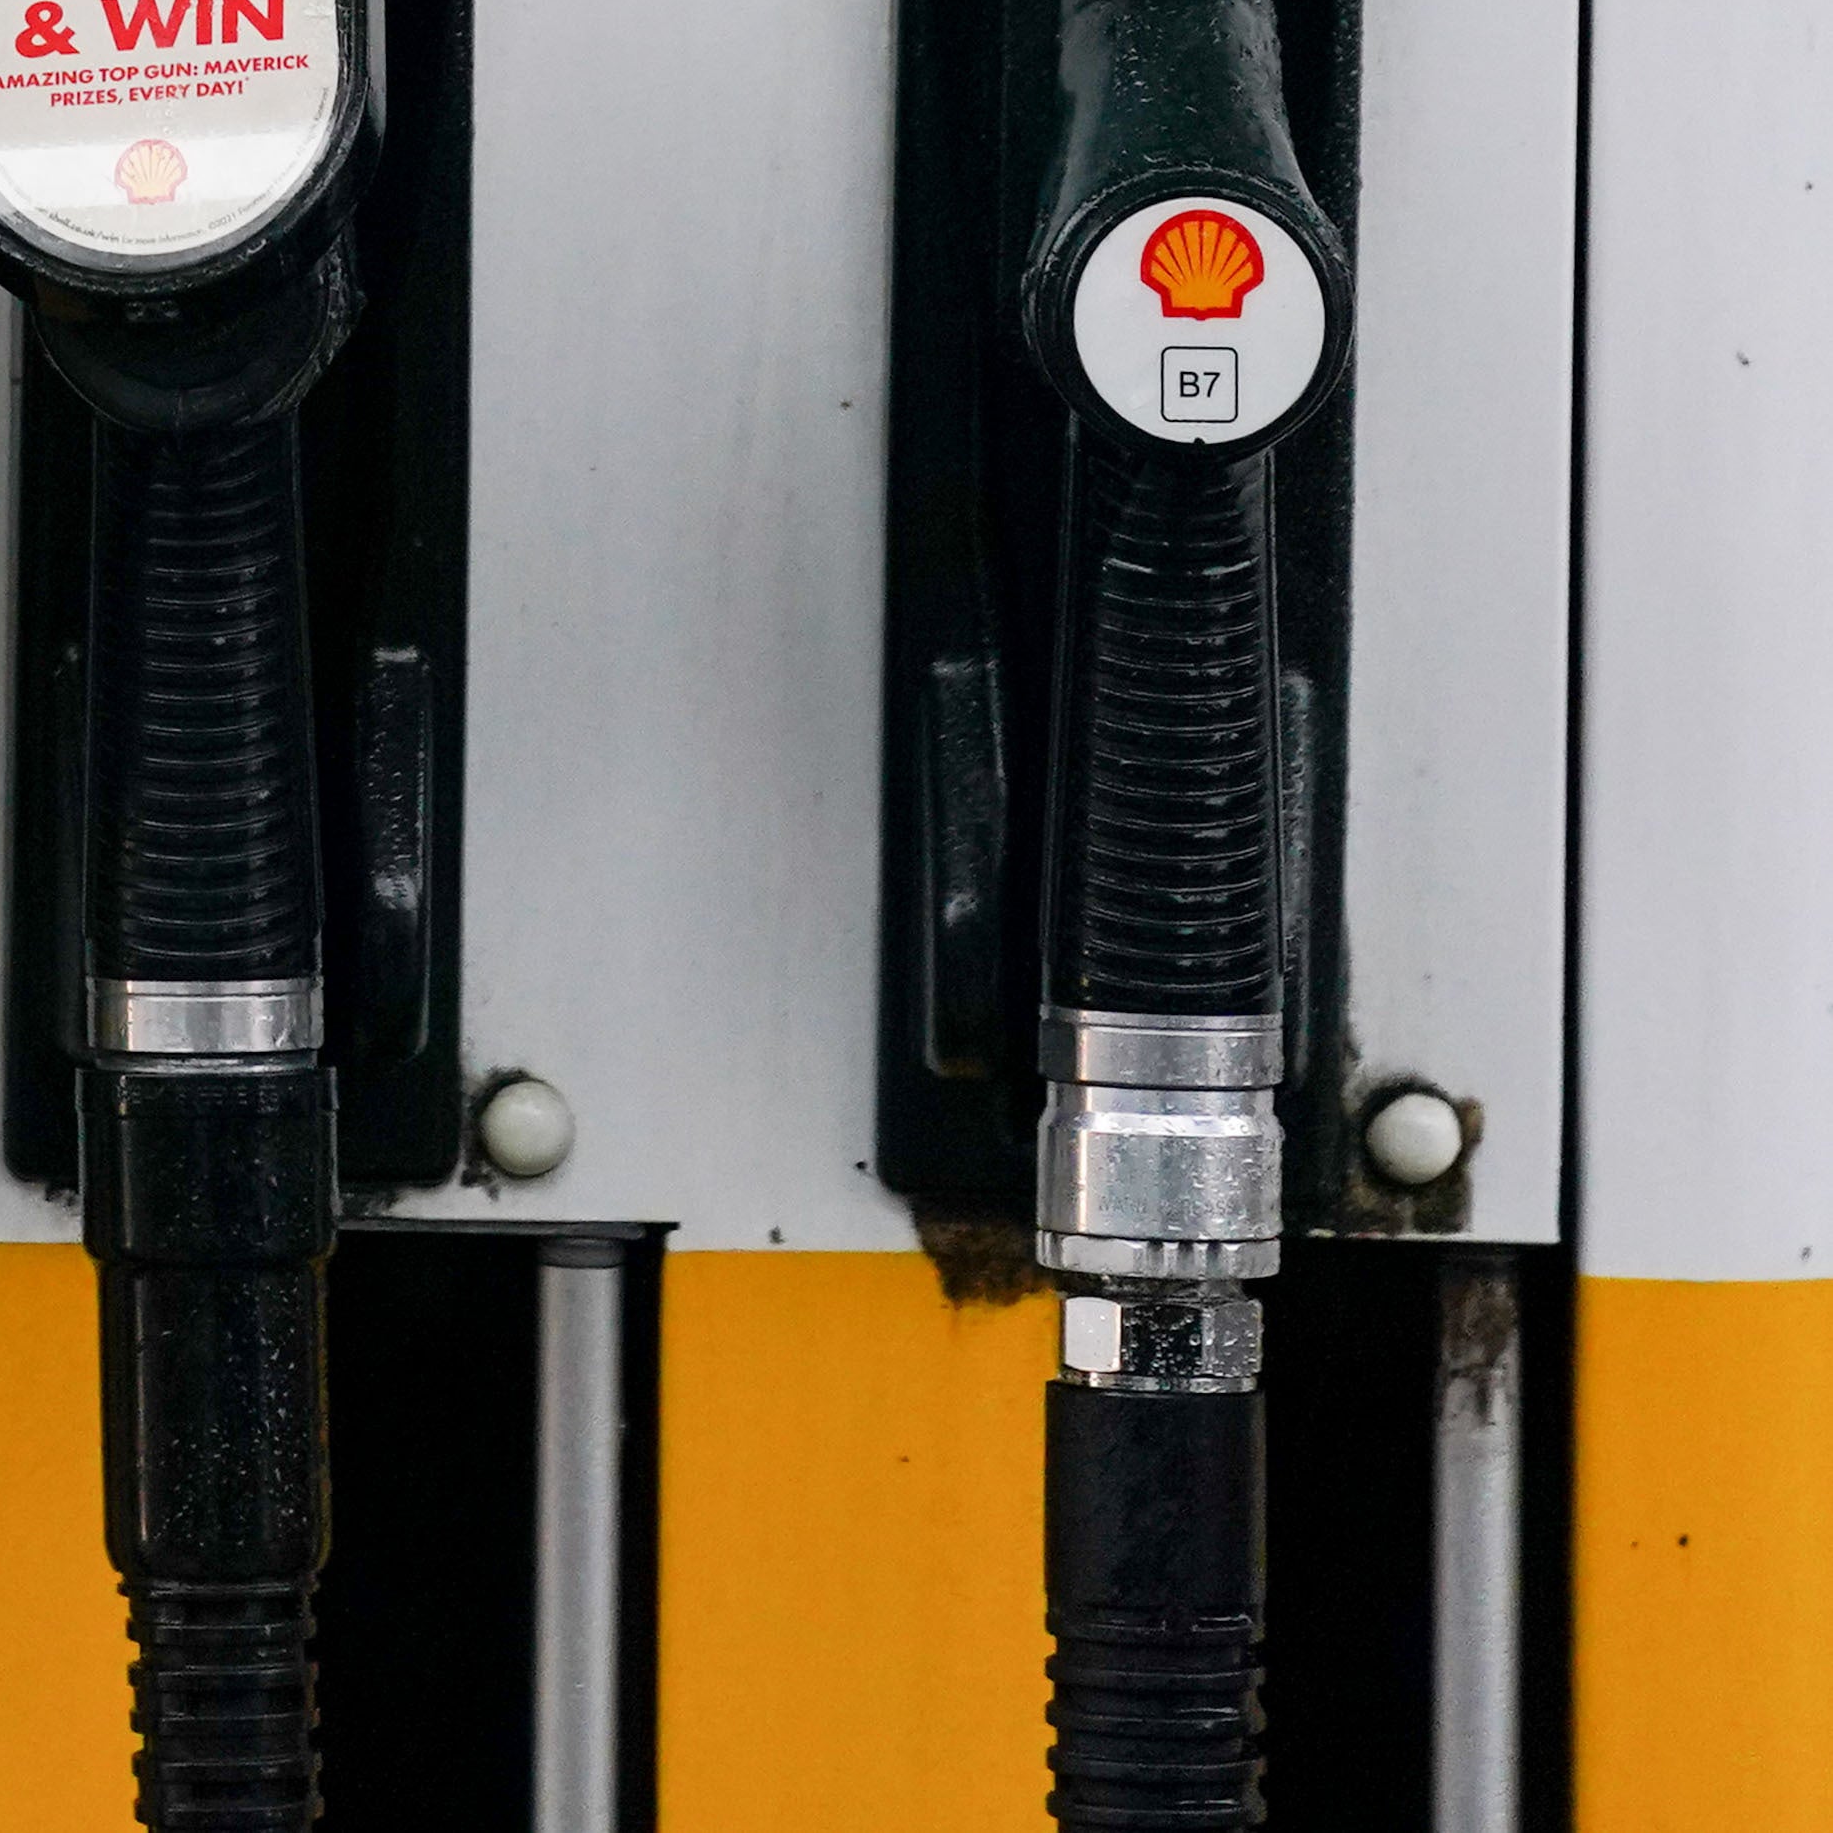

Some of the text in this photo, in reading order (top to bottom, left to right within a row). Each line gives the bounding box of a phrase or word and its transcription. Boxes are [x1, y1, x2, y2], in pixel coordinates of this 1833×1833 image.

[15, 1, 80, 58] &
[99, 66, 139, 82] TOP
[144, 63, 198, 79] GUN:
[204, 55, 309, 75] MAVERICK
[50, 90, 123, 107] PRIZES,
[129, 84, 190, 102] EVERY
[1179, 371, 1221, 398] B7
